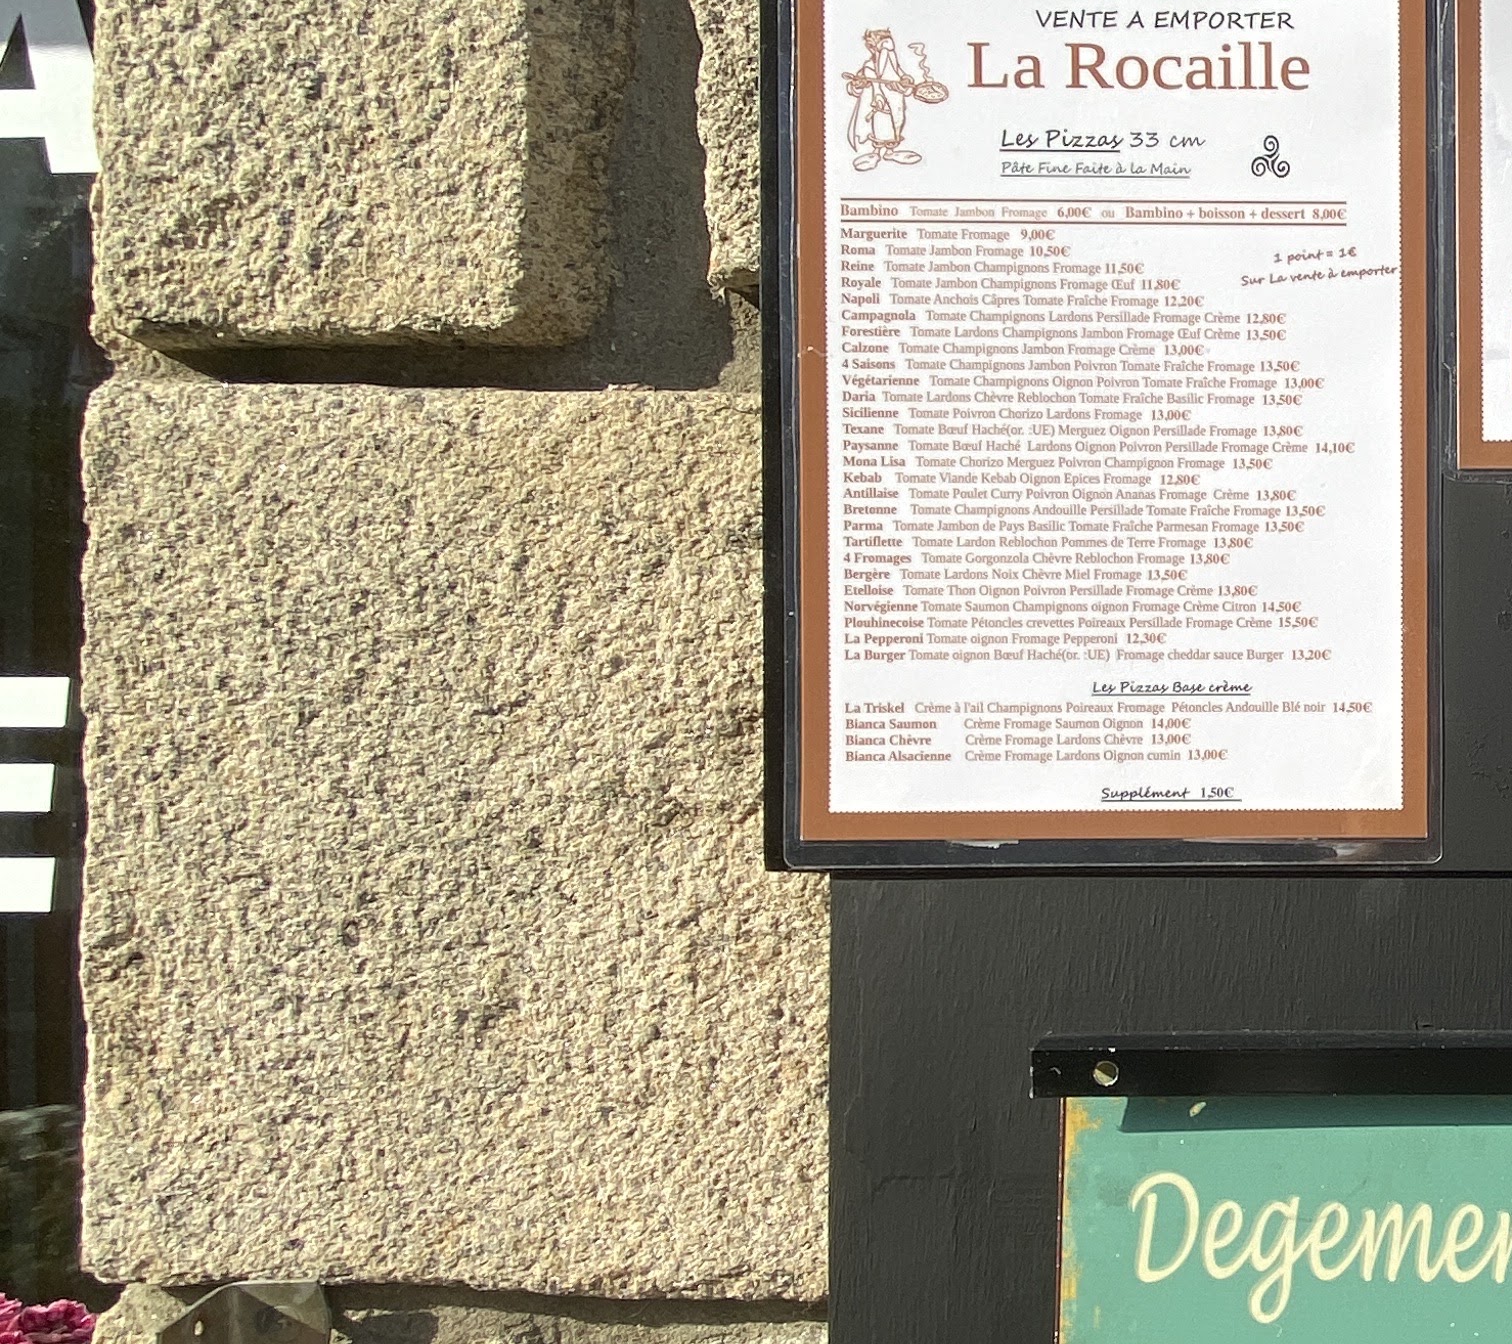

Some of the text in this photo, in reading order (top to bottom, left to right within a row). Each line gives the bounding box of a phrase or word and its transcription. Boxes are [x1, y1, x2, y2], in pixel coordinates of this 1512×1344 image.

[1036, 10, 1295, 30] VENTE A EMPORTER
[967, 42, 1311, 90] La Rocaille
[1001, 128, 1206, 149] Les Pizzas 33 cm
[1001, 161, 1192, 175] Pâte Fine Faite à la Main
[841, 205, 1346, 222] Bambino Tomate Jambon Fromage 6,00€ ou Bambino + boisson + dessert 8,00€
[840, 228, 1054, 243] Marguerite Tomate Fromage 9,00€
[1273, 252, 1283, 264] 1
[1286, 249, 1324, 265] point
[1339, 246, 1358, 258] 1€
[1241, 264, 1399, 287] Sur La vente à emporter
[842, 391, 1302, 407] Daria Tomate Lardons Chèvre Reblochon Tomate Fraîche Basilic Fromage 13,50€
[843, 472, 1200, 487] Kebab Tomate Viande Kebab Oignon Epices Fromage 12,80€
[844, 568, 1188, 582] Bergère Tomate Lardons Noix Chèvre Miel Fromage 13,50€
[1092, 679, 1253, 694] Les Pizzas Base crème
[1101, 786, 1235, 800] Supplément 1,50€
